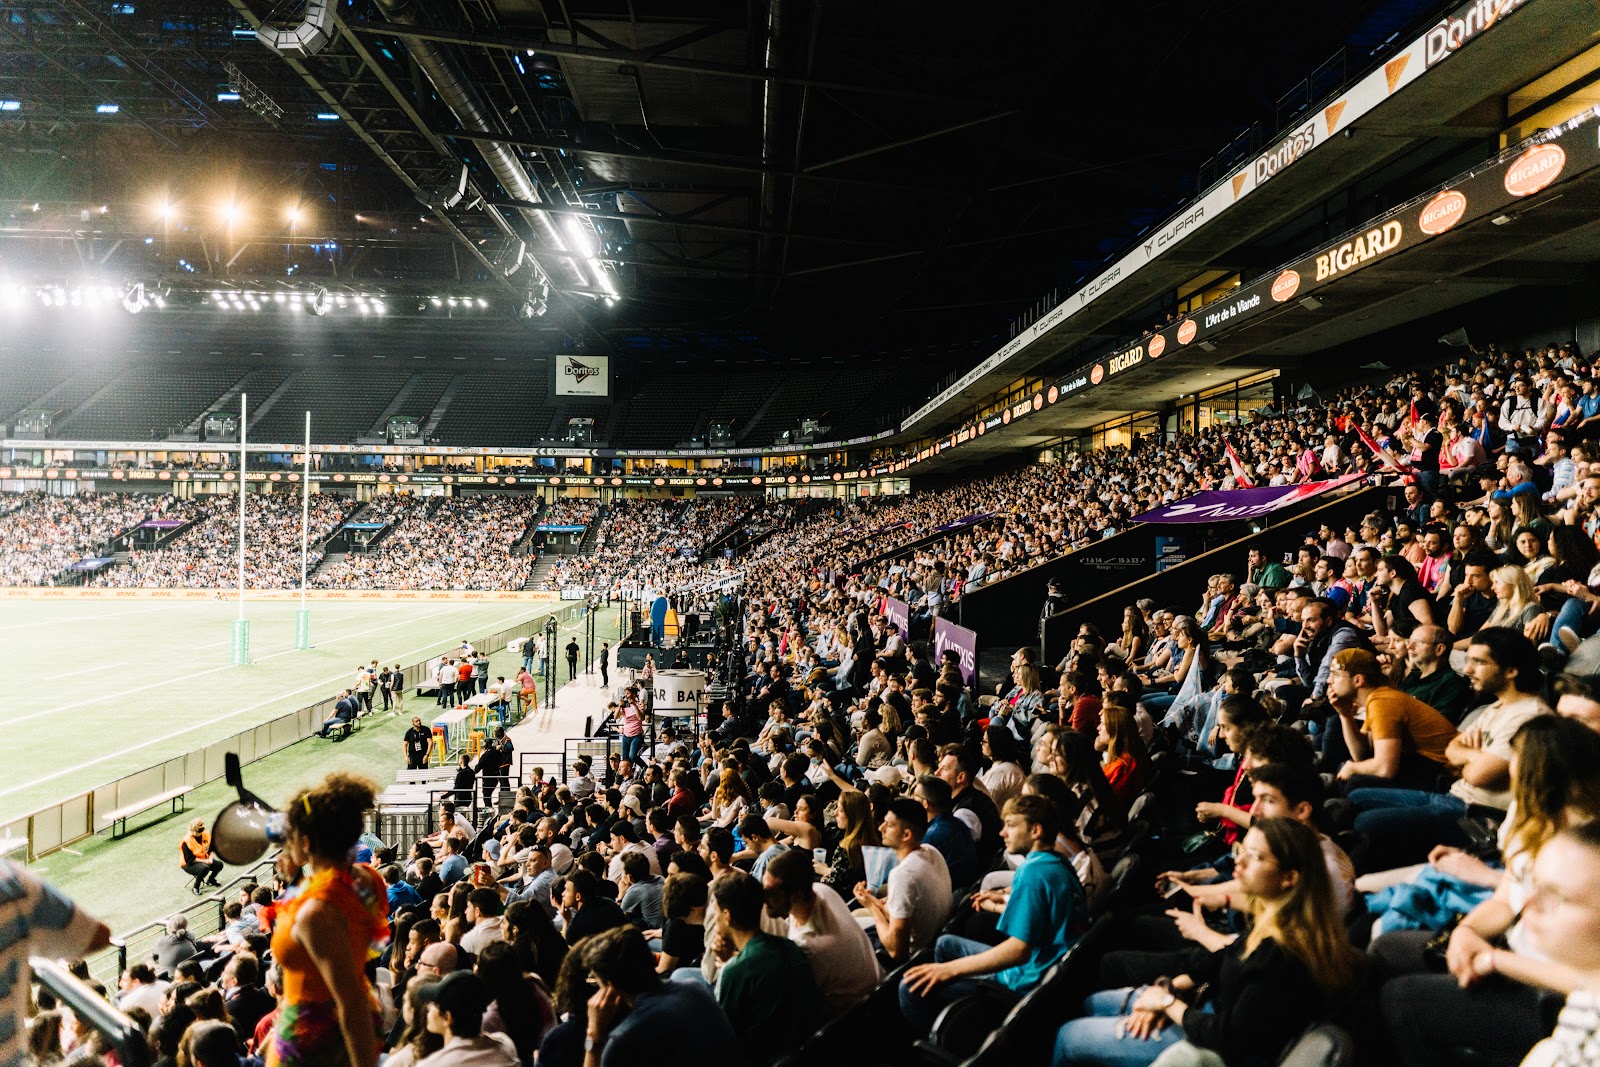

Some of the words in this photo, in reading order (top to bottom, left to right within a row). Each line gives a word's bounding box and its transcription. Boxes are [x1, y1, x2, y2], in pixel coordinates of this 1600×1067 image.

[1426, 0, 1530, 69] Dorit
[1256, 122, 1315, 187] Doritos
[1510, 154, 1559, 186] BIGARD
[1157, 206, 1204, 248] CUPRA
[1423, 199, 1462, 226] BIGARD
[1316, 219, 1402, 282] BIGARD
[1088, 267, 1121, 297] CUPRA
[1039, 309, 1063, 331] CUPRA
[1205, 312, 1221, 328] L'Art
[1221, 308, 1229, 320] de
[1230, 305, 1236, 317] la
[1237, 294, 1261, 314] Viande
[565, 365, 599, 376] Doritos
[1109, 345, 1144, 375] BIGARD
[765, 476, 785, 484] BIGARD
